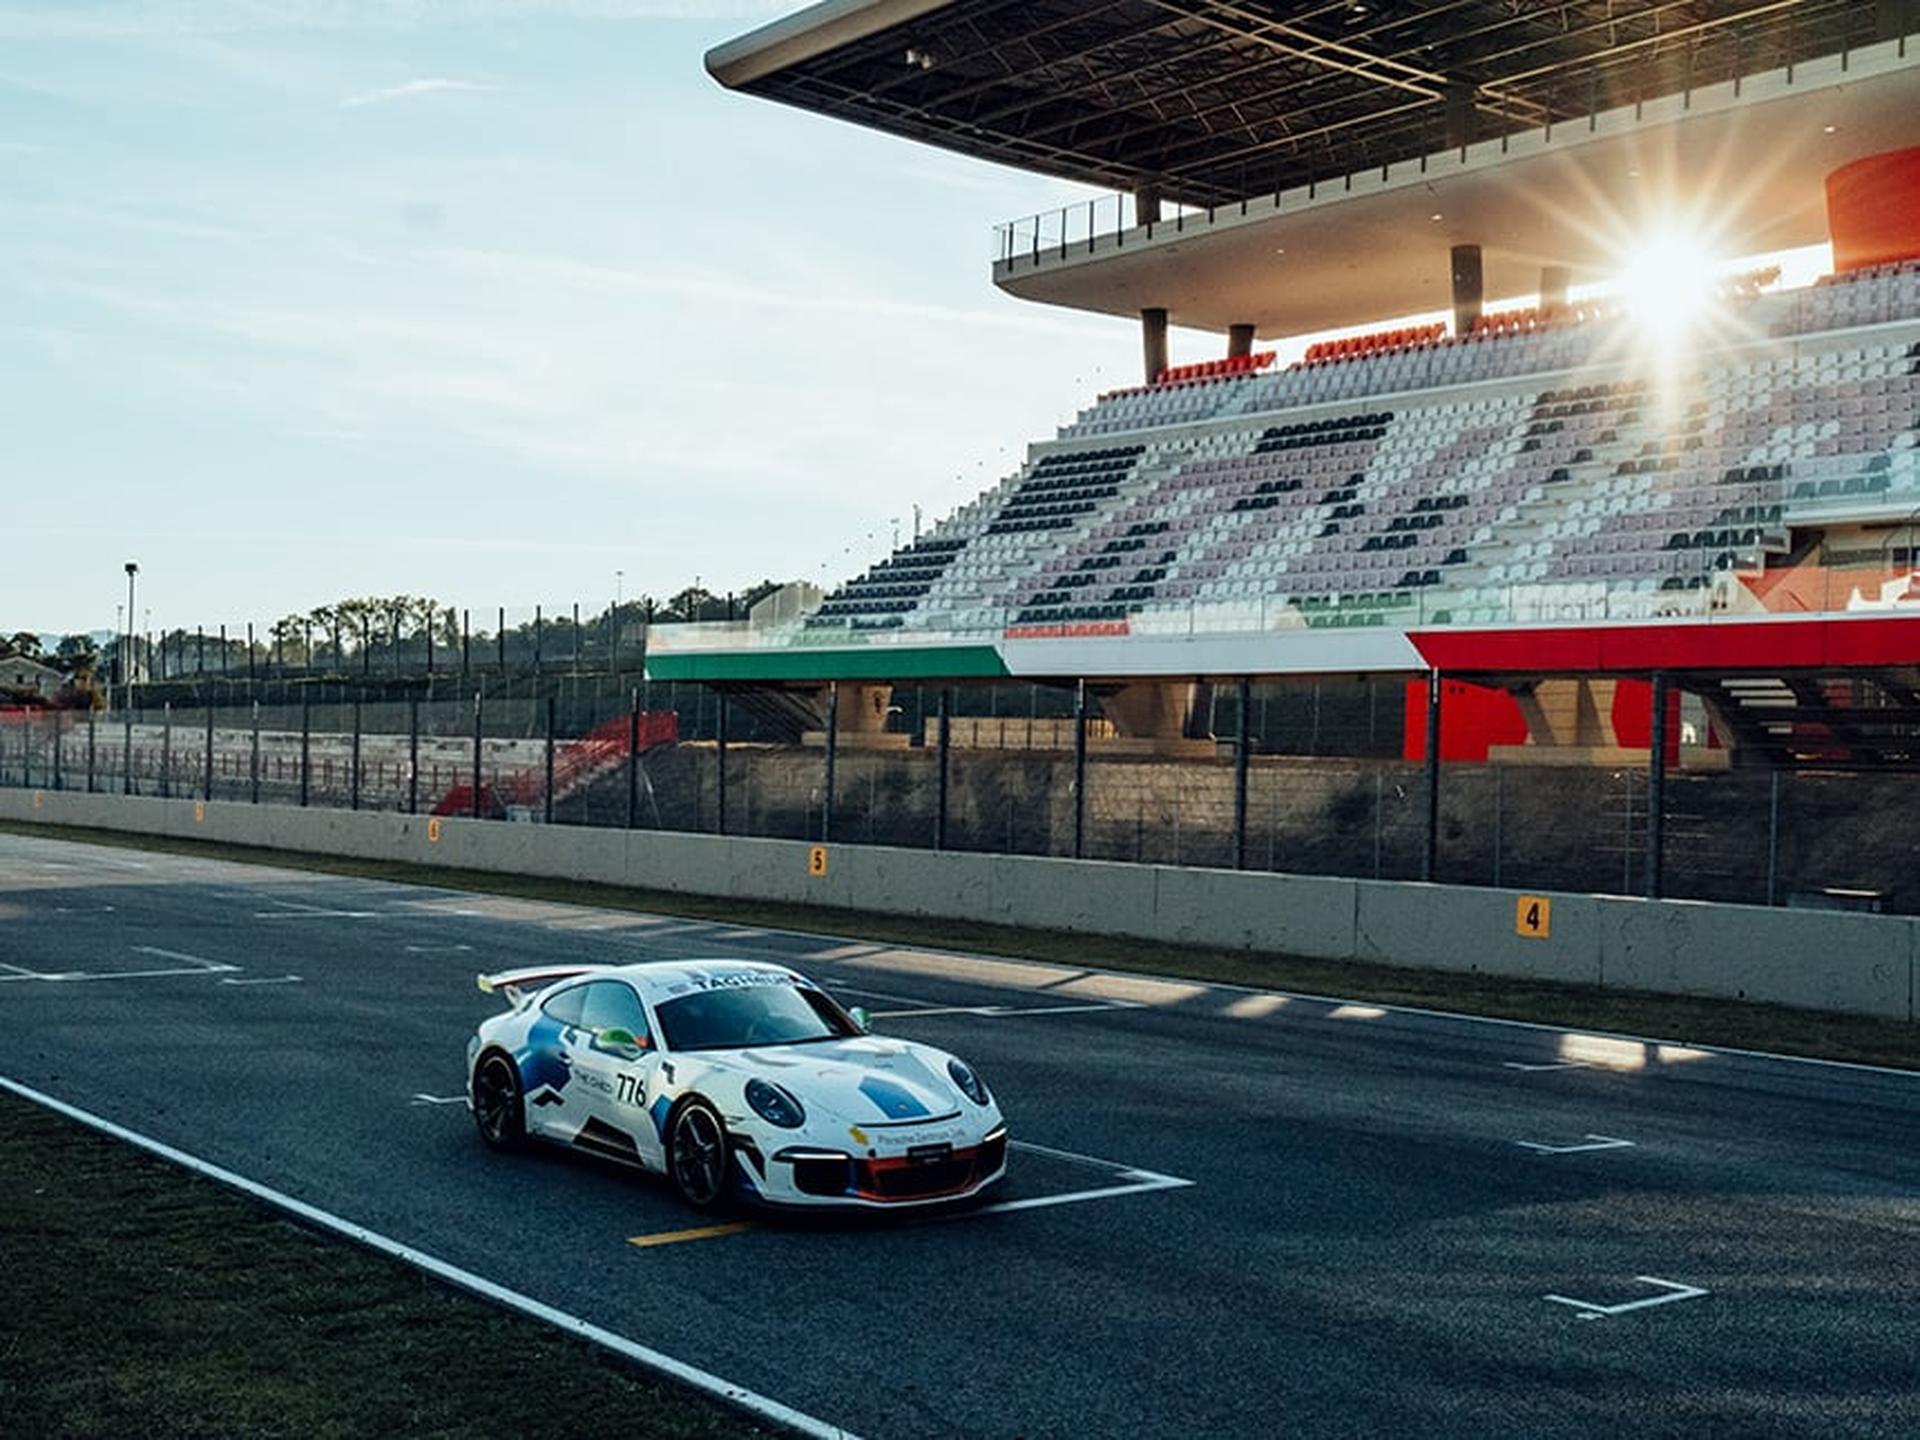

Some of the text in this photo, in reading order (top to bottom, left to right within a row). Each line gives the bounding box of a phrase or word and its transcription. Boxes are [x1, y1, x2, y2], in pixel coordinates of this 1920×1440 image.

[814, 850, 822, 871] 5
[1526, 902, 1539, 930] 4
[617, 1073, 646, 1107] 776
